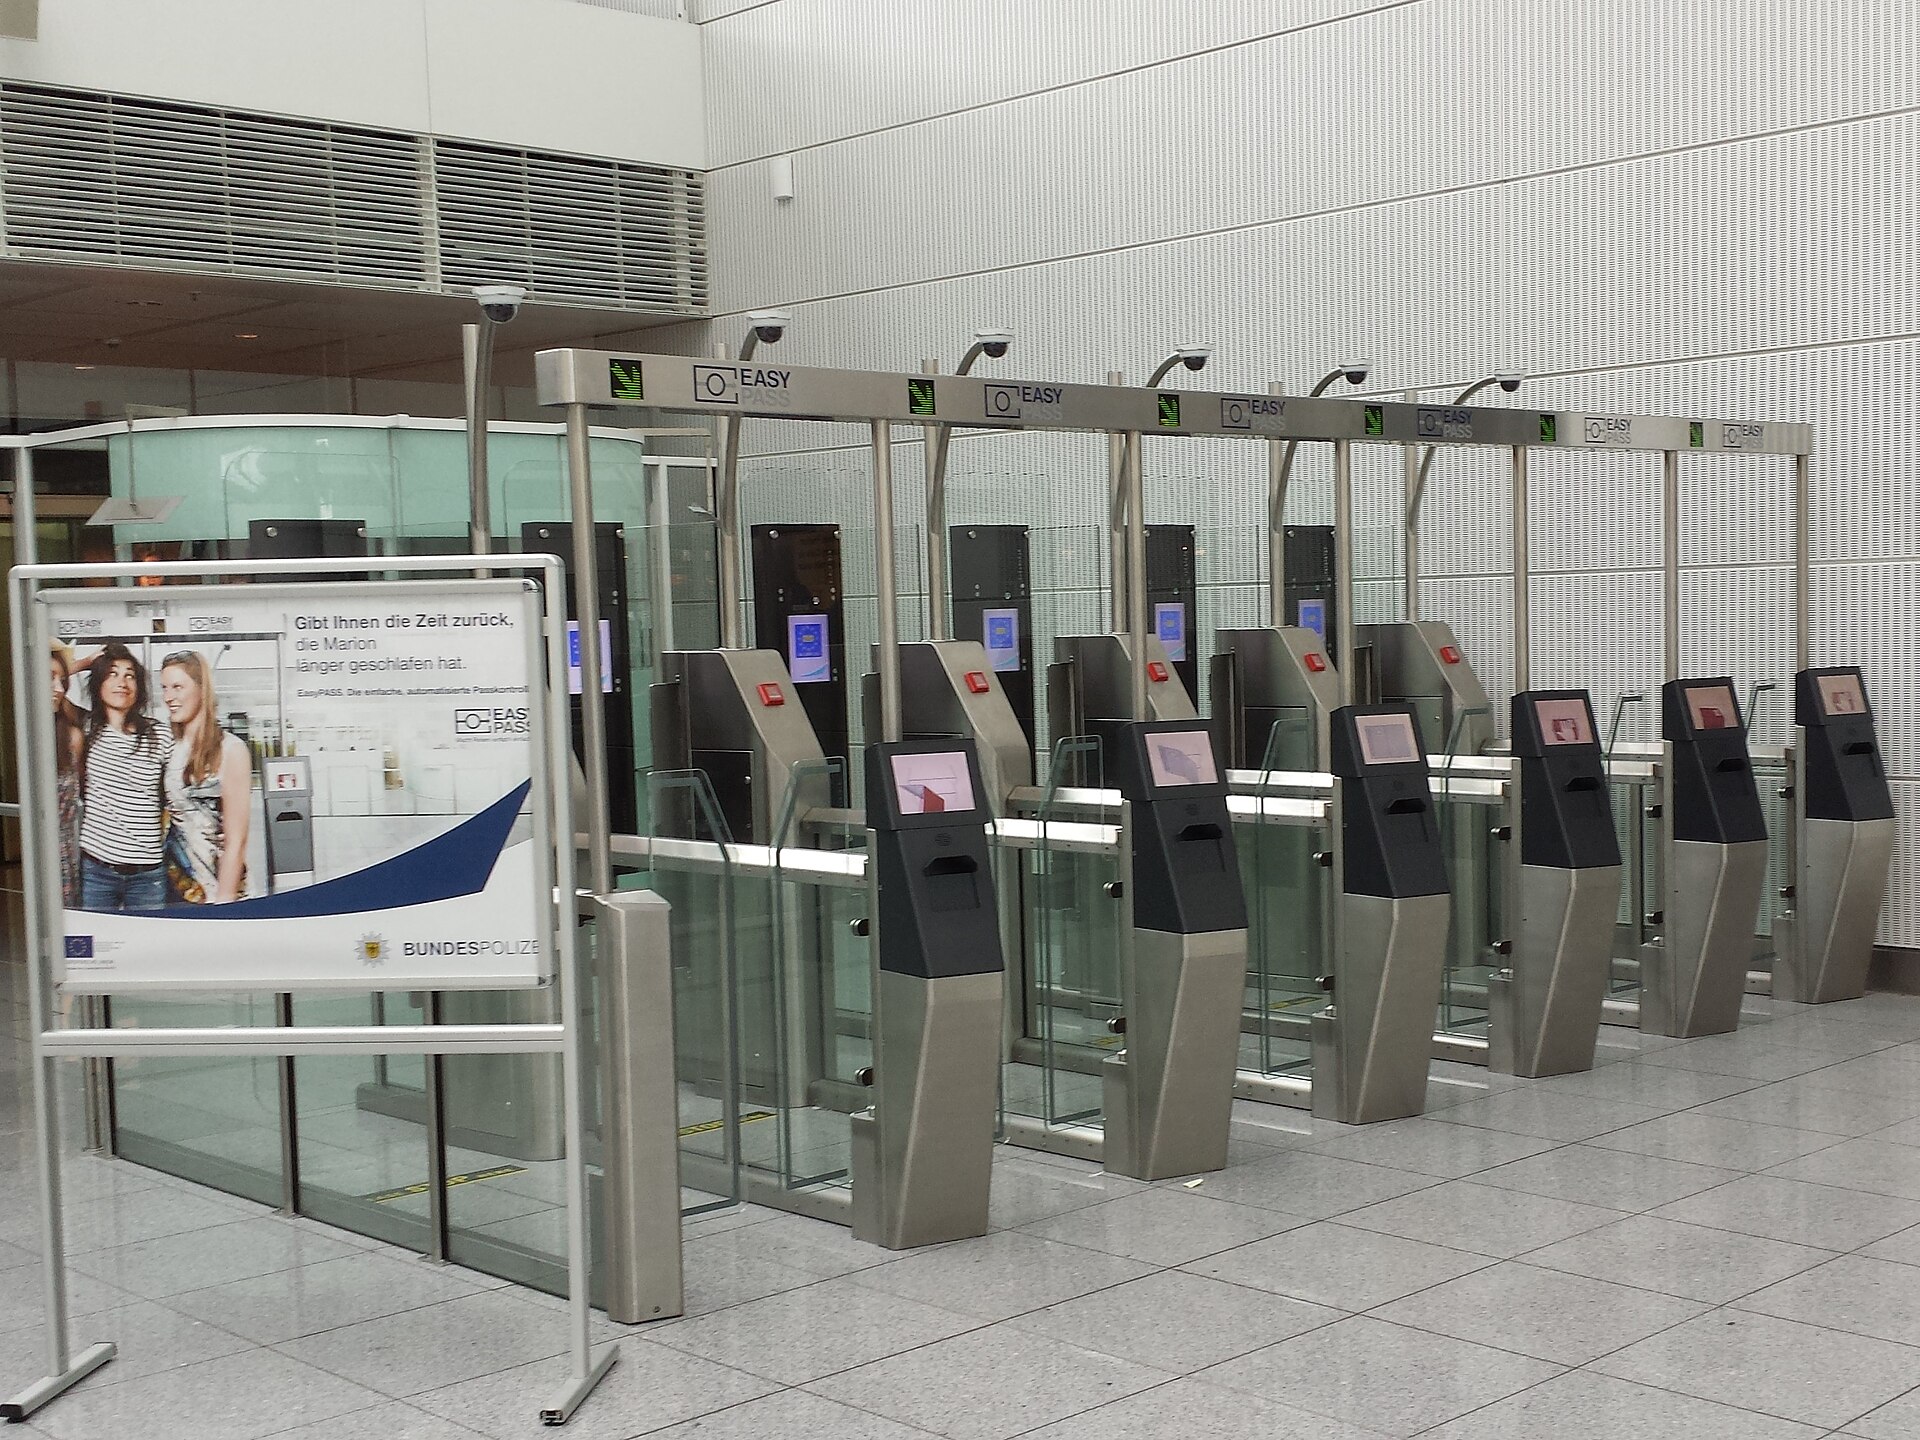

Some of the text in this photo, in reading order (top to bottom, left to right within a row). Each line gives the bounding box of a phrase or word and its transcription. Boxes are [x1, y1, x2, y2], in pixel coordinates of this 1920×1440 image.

[740, 368, 790, 388] EASY
[741, 387, 790, 407] PASS
[1022, 386, 1063, 404] EASY
[1252, 399, 1286, 416] EASY
[1444, 410, 1473, 424] EASY
[1607, 418, 1632, 431] EASY
[1443, 424, 1473, 439] PASS
[1742, 424, 1764, 438] EASY
[295, 612, 514, 630] Gibt Ihnen die Zeit zurück,
[296, 636, 377, 651] die Marion
[296, 656, 467, 675] länger geschlafen hat.
[493, 708, 530, 721] EAS
